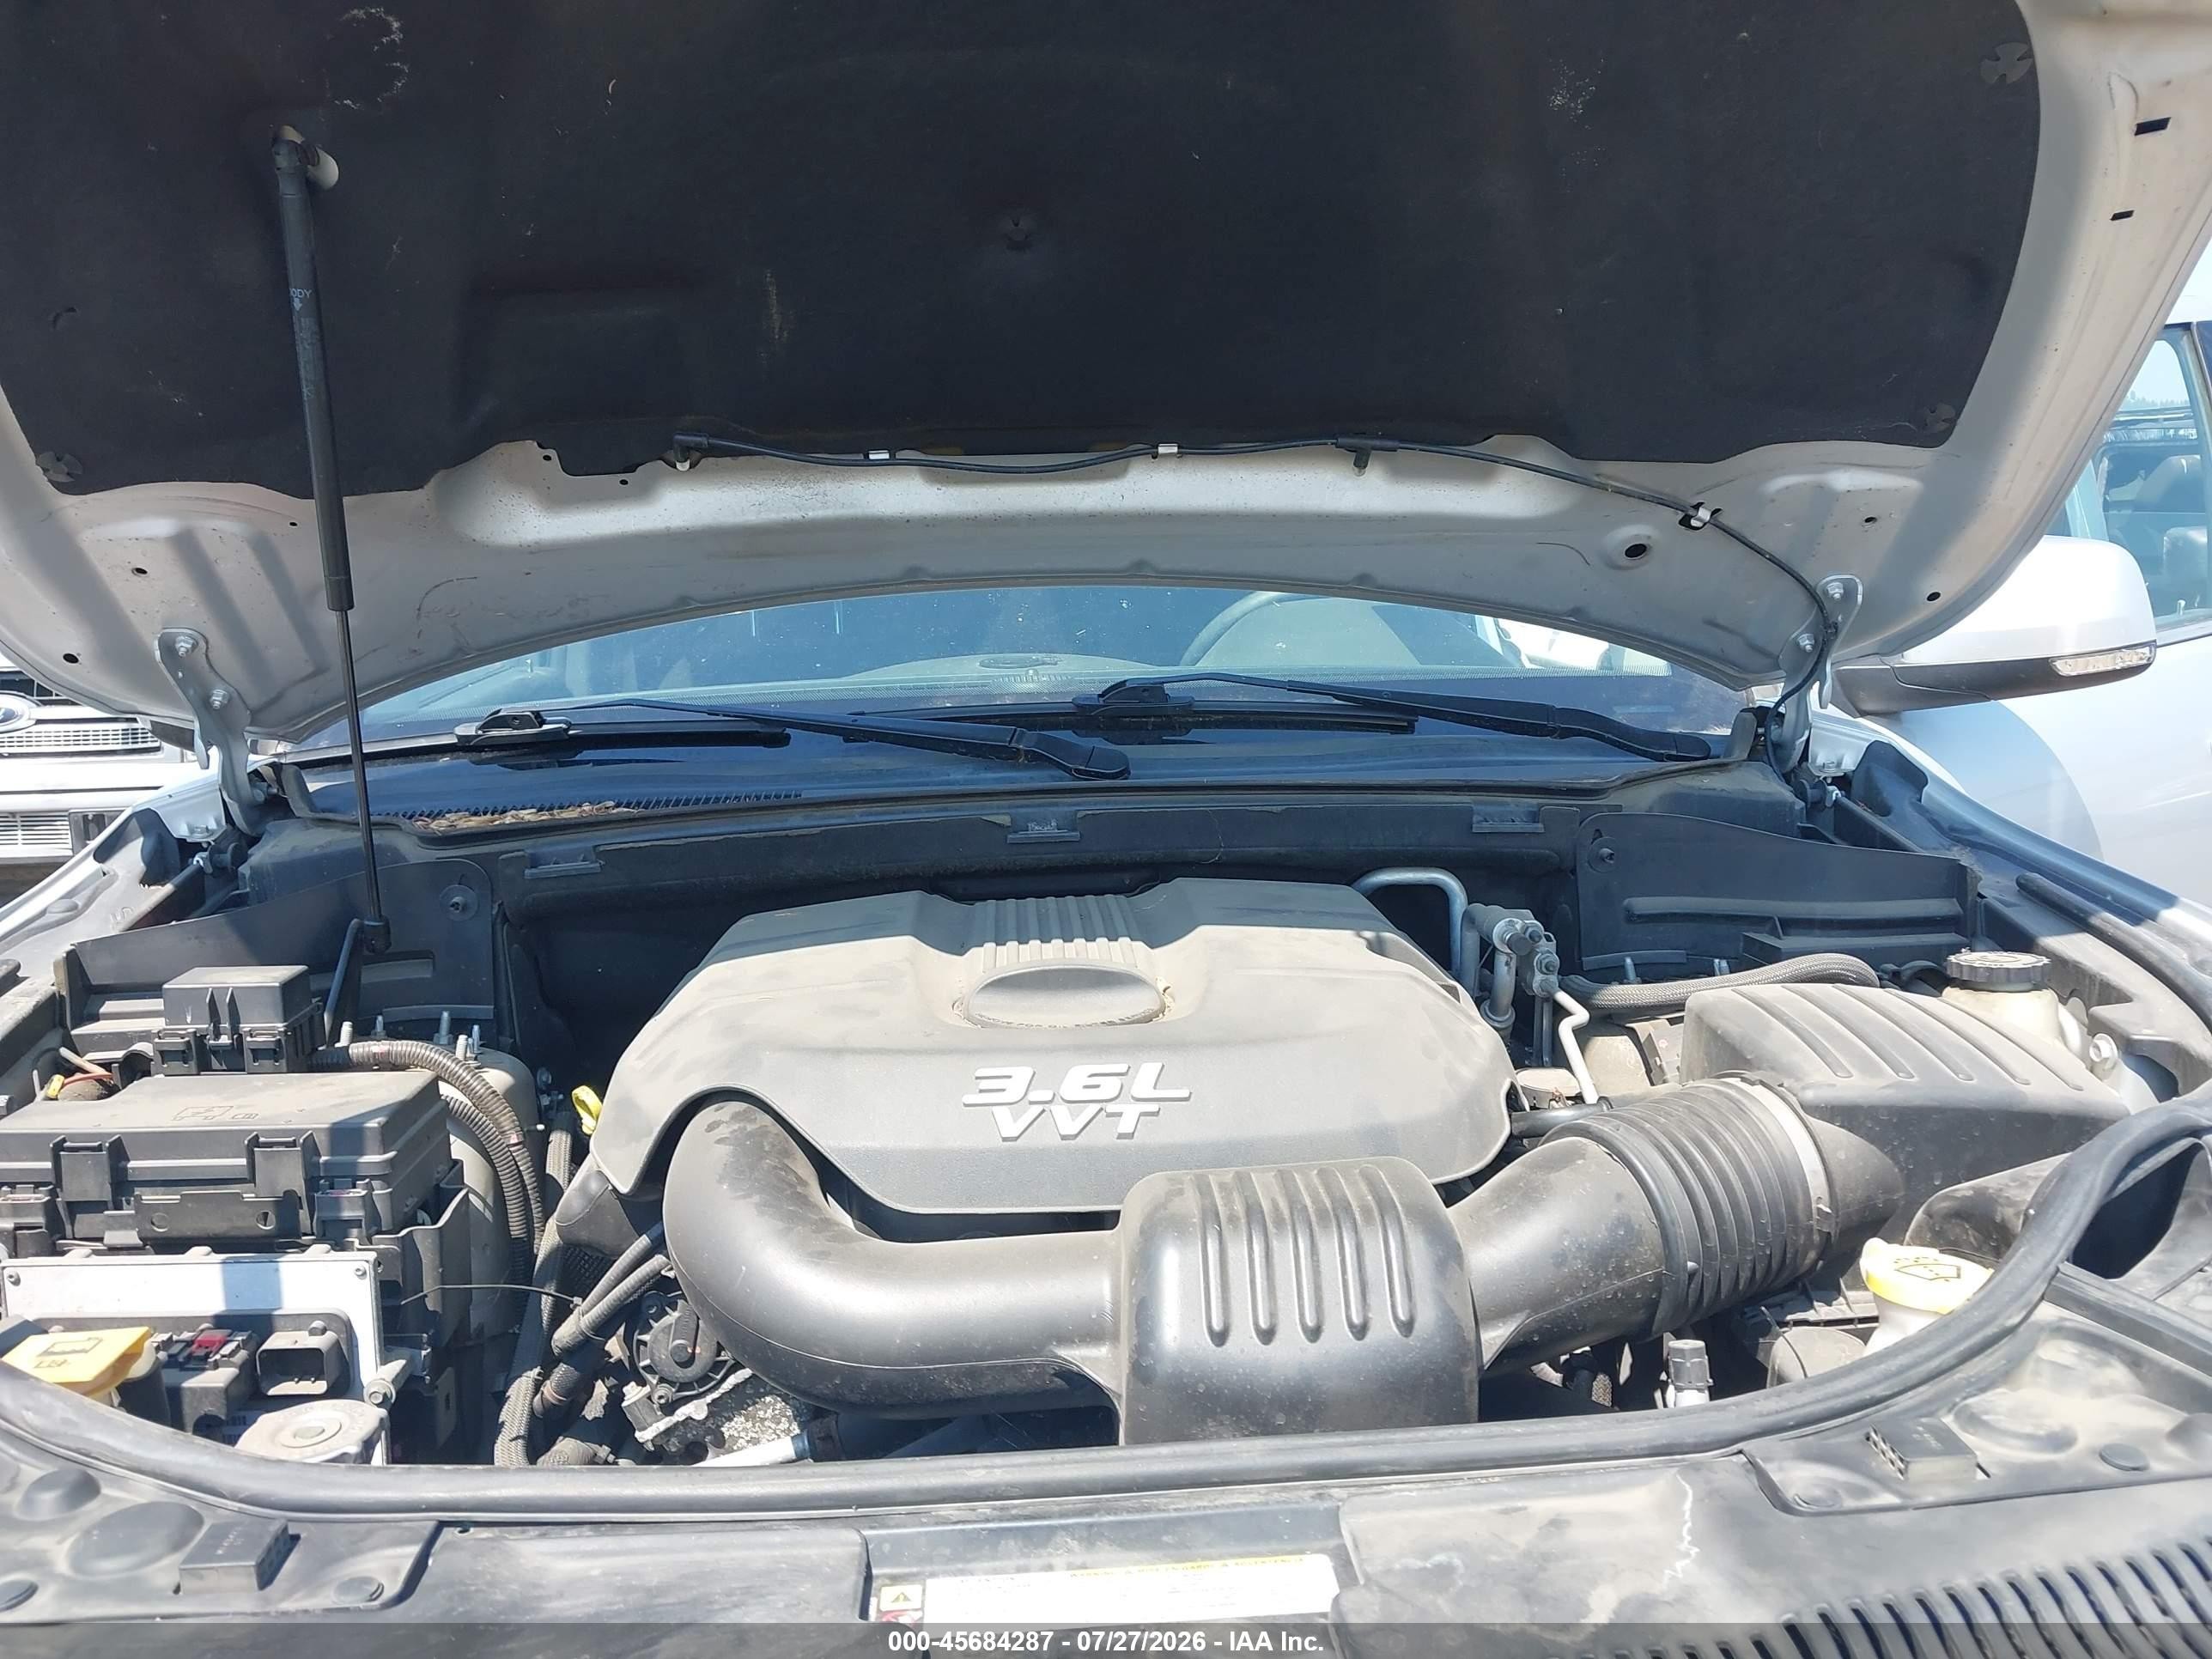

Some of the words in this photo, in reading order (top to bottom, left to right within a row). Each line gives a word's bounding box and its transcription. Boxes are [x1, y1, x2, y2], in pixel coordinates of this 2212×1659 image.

[289, 288, 313, 299] ODY
[962, 1061, 1192, 1107] 3.6L
[991, 1103, 1161, 1142] VVT
